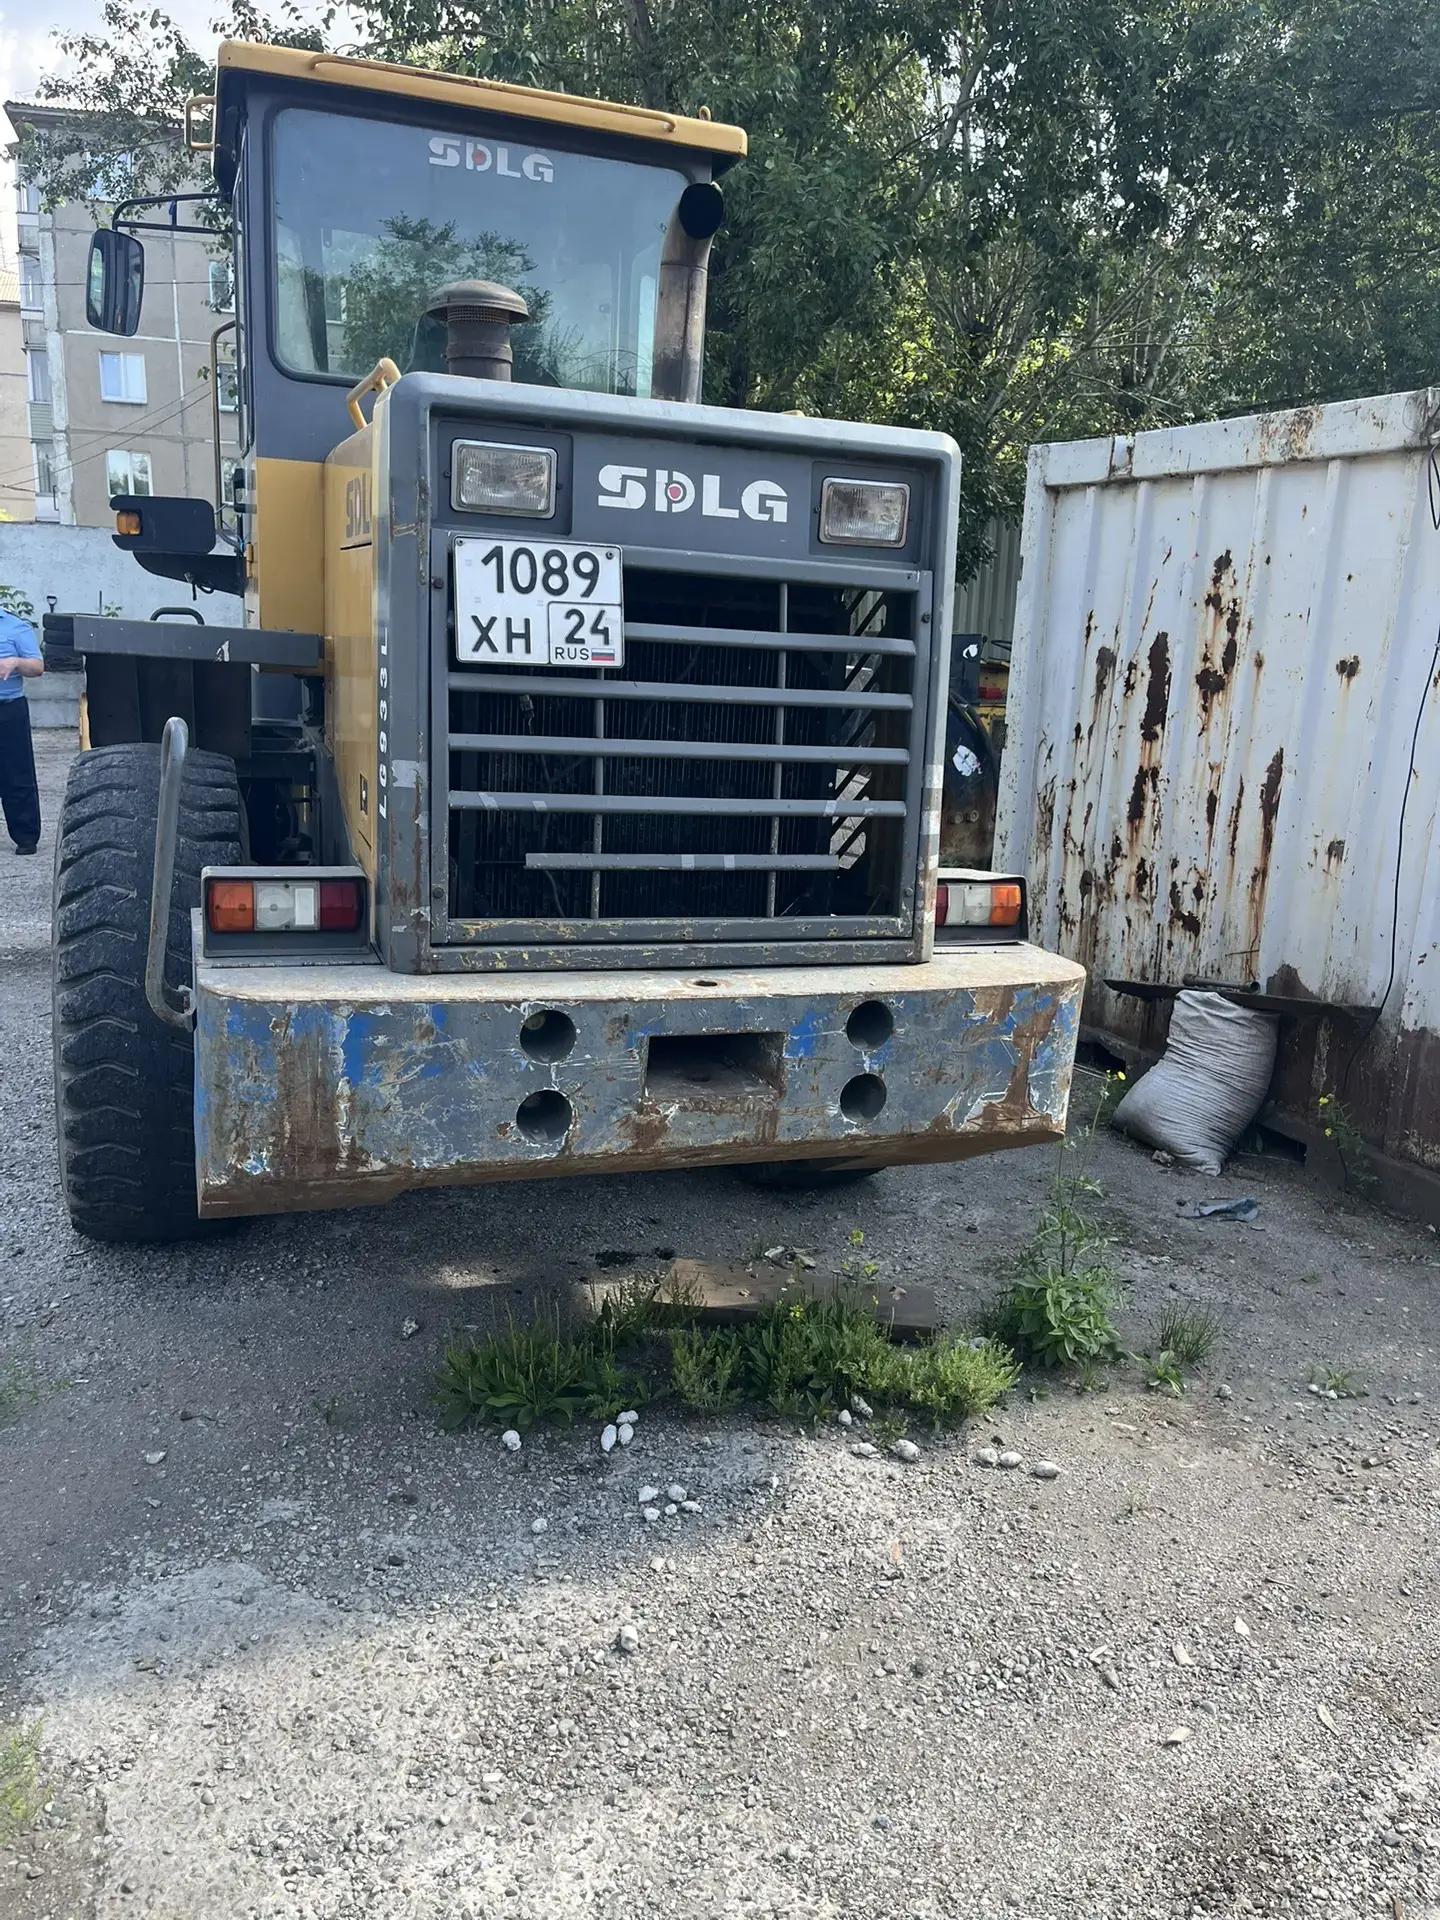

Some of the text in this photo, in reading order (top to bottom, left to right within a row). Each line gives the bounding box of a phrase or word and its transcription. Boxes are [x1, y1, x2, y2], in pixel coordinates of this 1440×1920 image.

[428, 136, 554, 183] SDLG
[346, 472, 373, 538] SDL
[597, 464, 788, 523] SDLG
[481, 545, 600, 598] 1089
[554, 646, 589, 660] RUS
[564, 608, 610, 646] 24
[378, 626, 389, 820] LG933L
